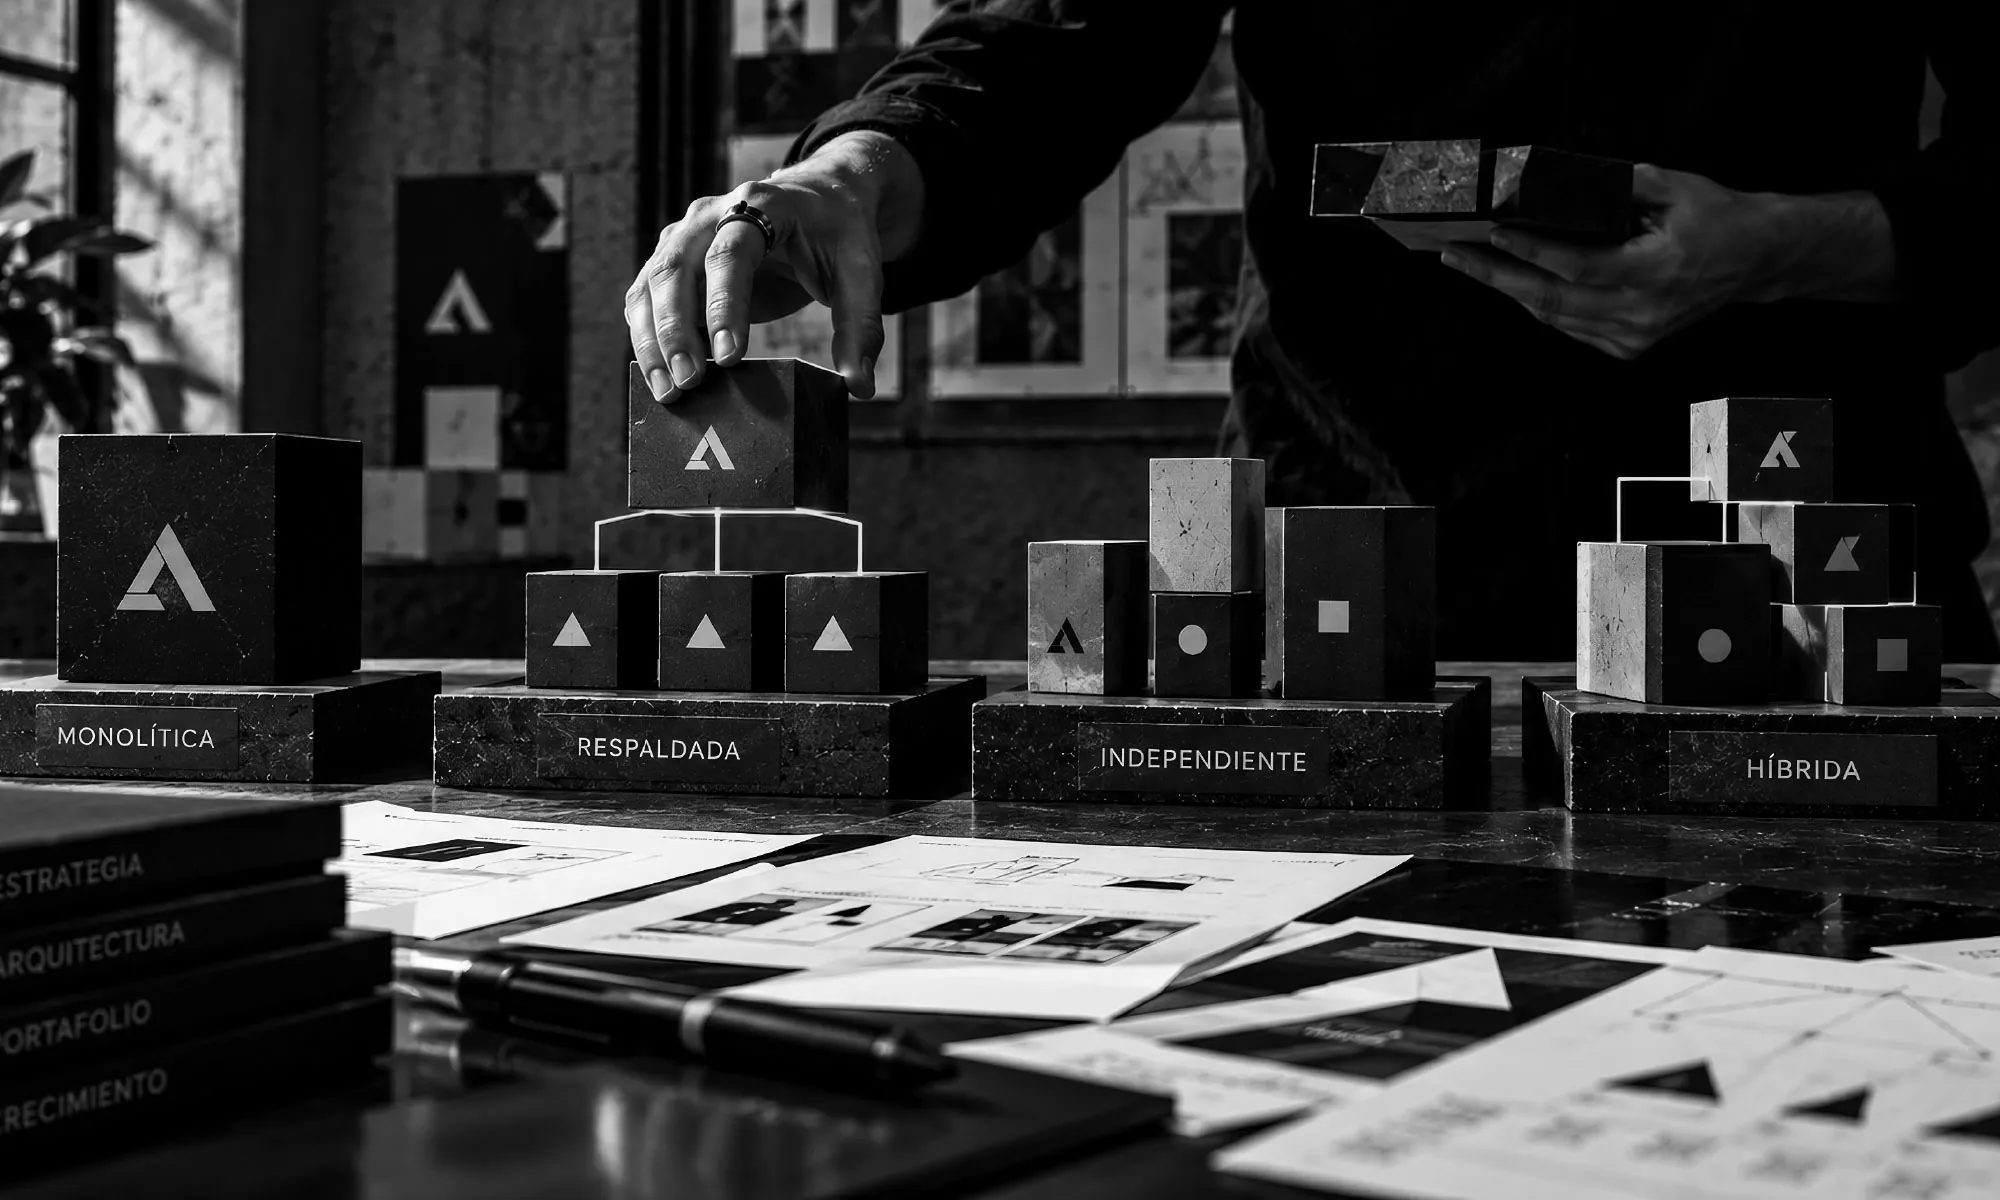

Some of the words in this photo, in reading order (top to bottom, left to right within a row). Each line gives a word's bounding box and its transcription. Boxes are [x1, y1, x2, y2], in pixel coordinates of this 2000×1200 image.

[57, 724, 215, 749] MONOLÍTICA
[578, 737, 741, 761] RESPALDADA
[1101, 747, 1307, 772] INDEPENDIENTE
[1747, 752, 1861, 781] HÍBRIDA
[0, 998, 153, 1056] ORTAFOLIO
[0, 1067, 169, 1136] RECIMIENTO
